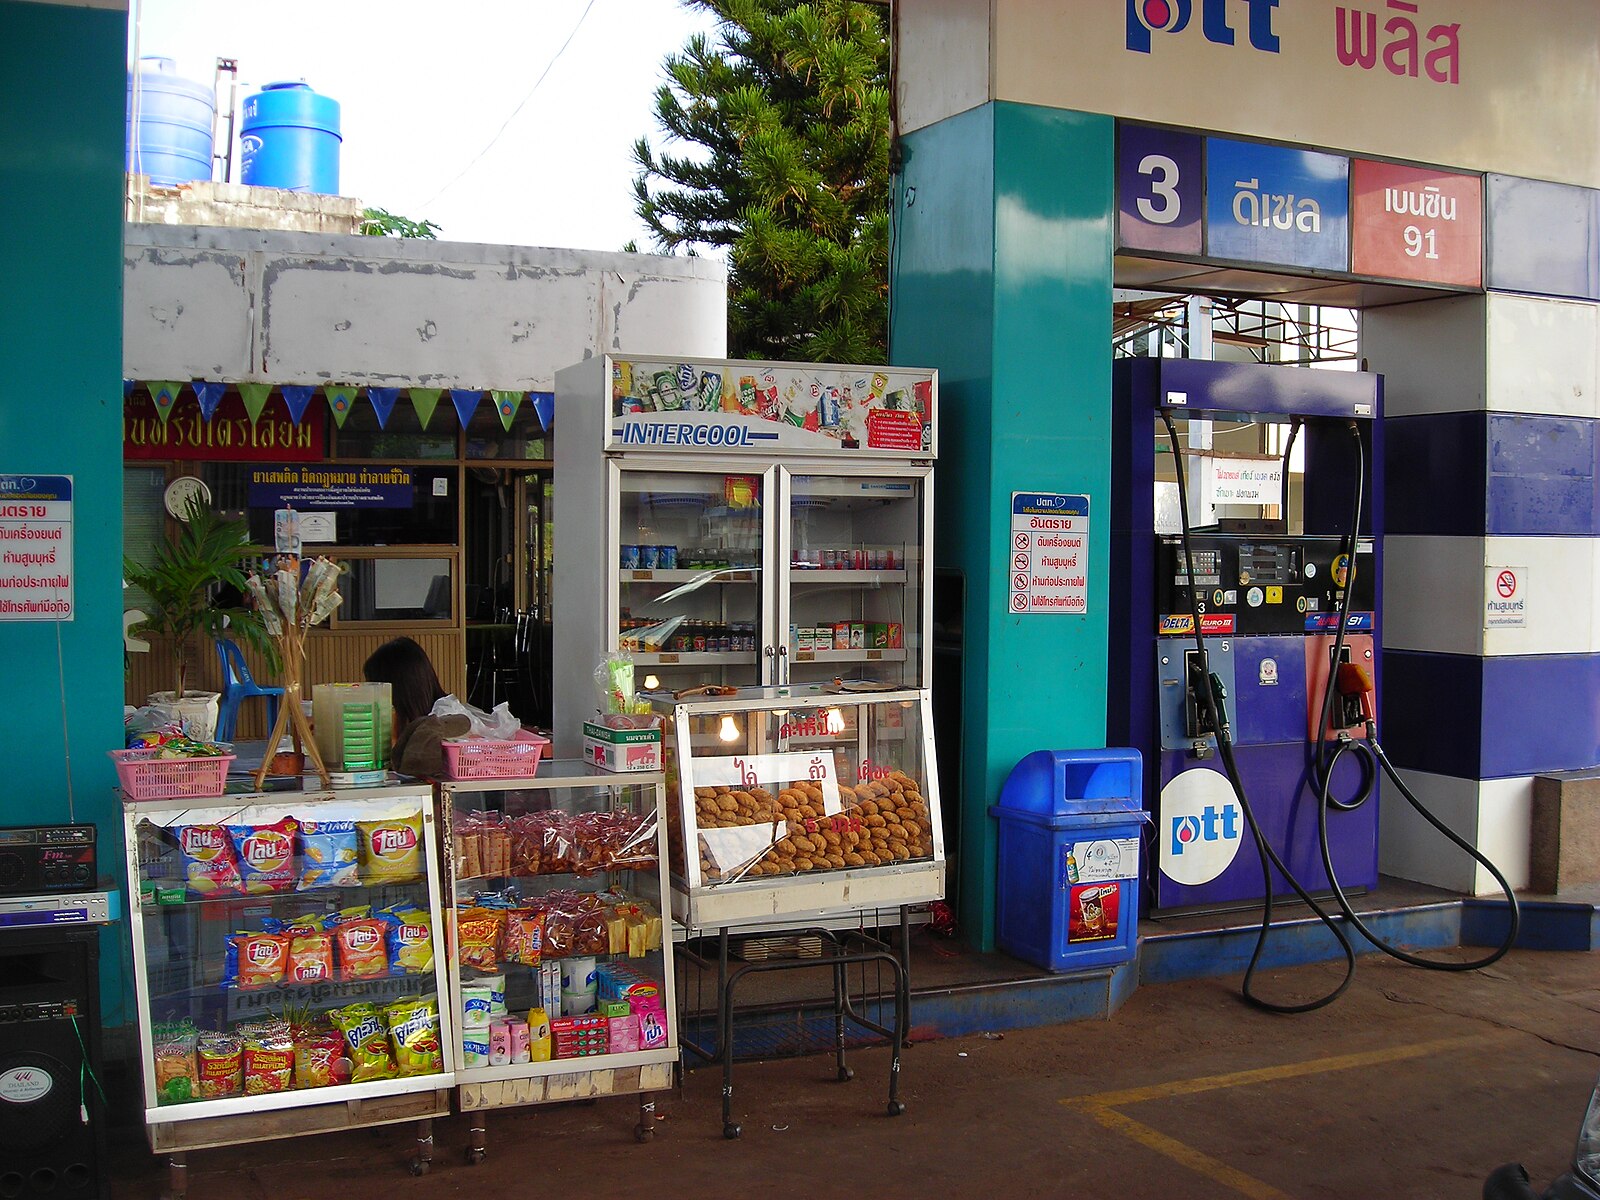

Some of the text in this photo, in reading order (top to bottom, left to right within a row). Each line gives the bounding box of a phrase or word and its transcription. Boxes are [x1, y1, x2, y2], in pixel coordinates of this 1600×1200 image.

[1136, 154, 1180, 224] 3
[1232, 178, 1321, 233] ดีเซล
[1385, 186, 1456, 221] เบนซิน
[1403, 226, 1439, 259] 91
[622, 422, 754, 447] INTERCOOL
[0, 480, 20, 490] ตท.
[1036, 498, 1055, 507] ปตท.
[0, 505, 46, 517] นตราย
[1030, 516, 1072, 529] อันตราย
[1037, 534, 1082, 548] ดับเครื่องยนต์
[3, 546, 56, 568] ห้ามสูบบุหรี่
[1041, 553, 1077, 570] ห้ามสูบบุหรี่
[1032, 576, 1085, 587] ห้ามก่อประกายไฟ
[1197, 602, 1206, 613] 3
[1487, 599, 1524, 613] ห้ามสูบบุหรี่
[1163, 617, 1190, 629] DELTA
[1347, 616, 1364, 626] 91
[1221, 641, 1230, 652] 5
[734, 757, 758, 786] ไก่
[809, 757, 827, 779] ถั่ว
[1171, 804, 1238, 856] ptt
